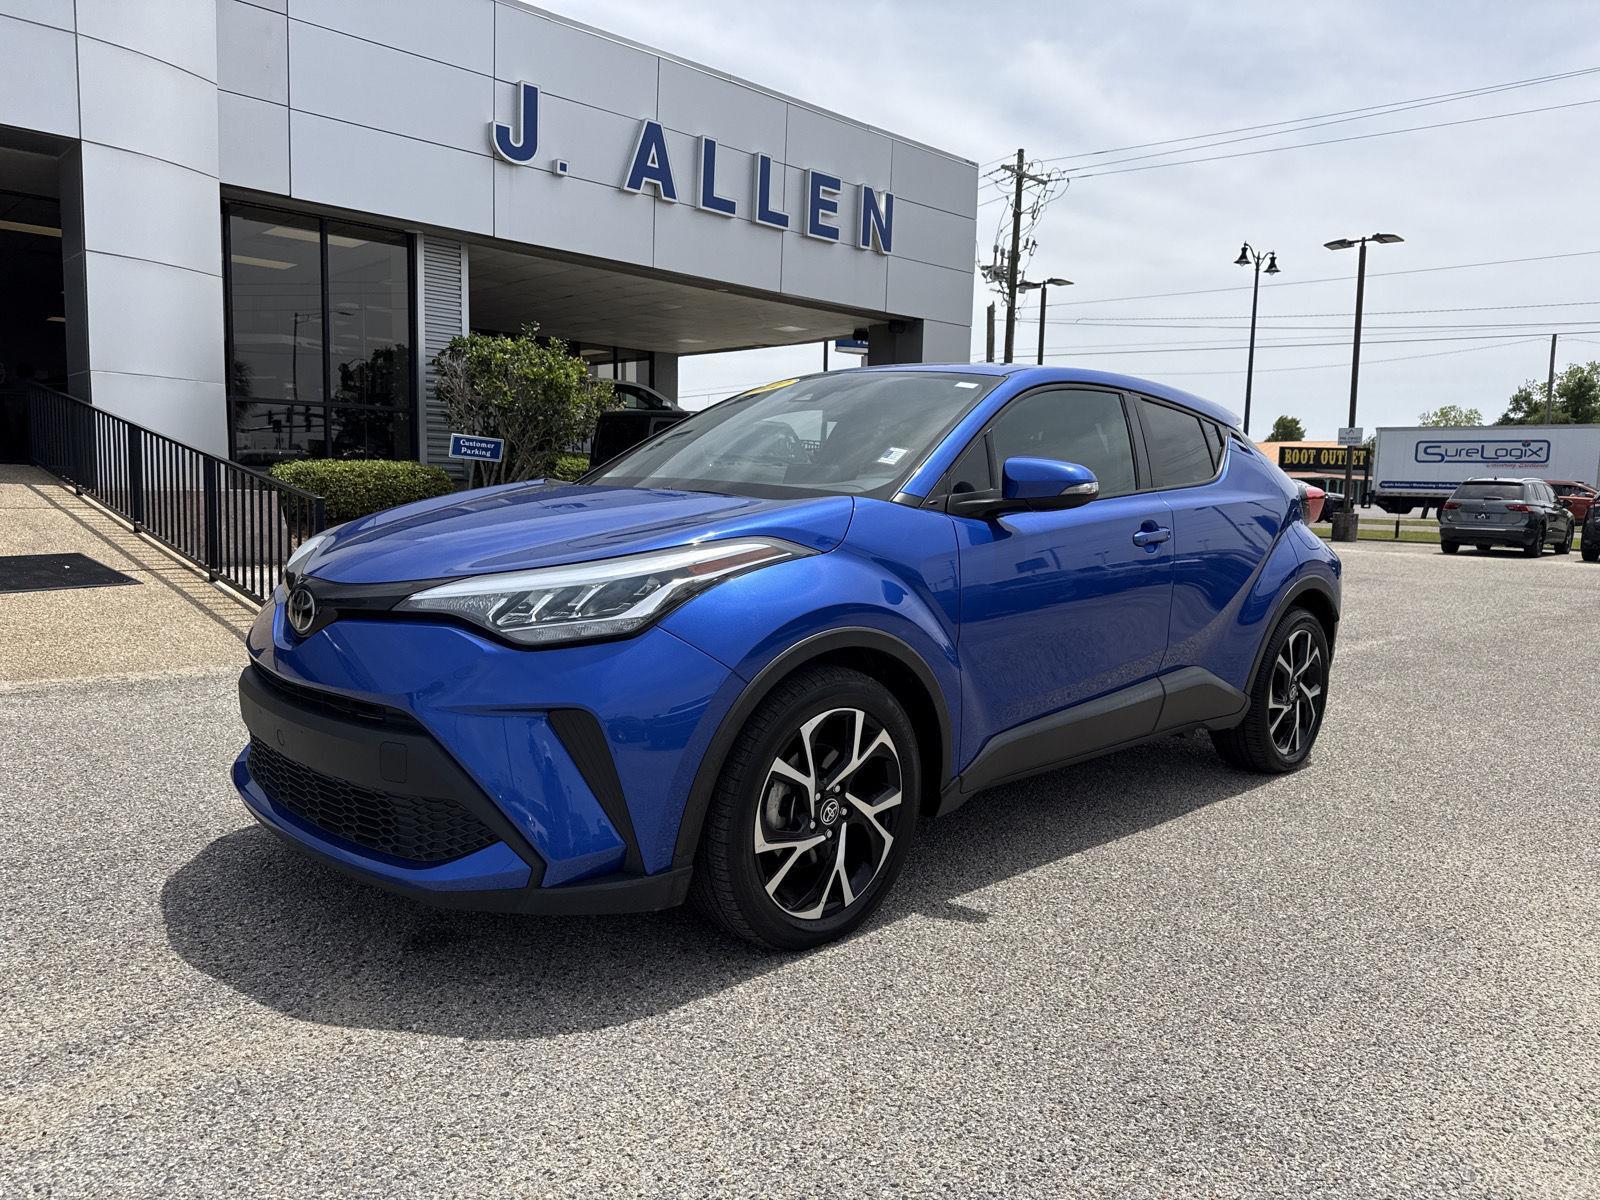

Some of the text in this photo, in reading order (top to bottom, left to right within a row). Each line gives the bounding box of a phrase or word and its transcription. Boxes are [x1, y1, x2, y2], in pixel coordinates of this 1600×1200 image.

[488, 80, 895, 255] J. ALLEN
[460, 439, 495, 449] Customer
[461, 446, 491, 457] Parking
[1423, 440, 1543, 462] SureLogix
[1284, 448, 1316, 464] BOOT
